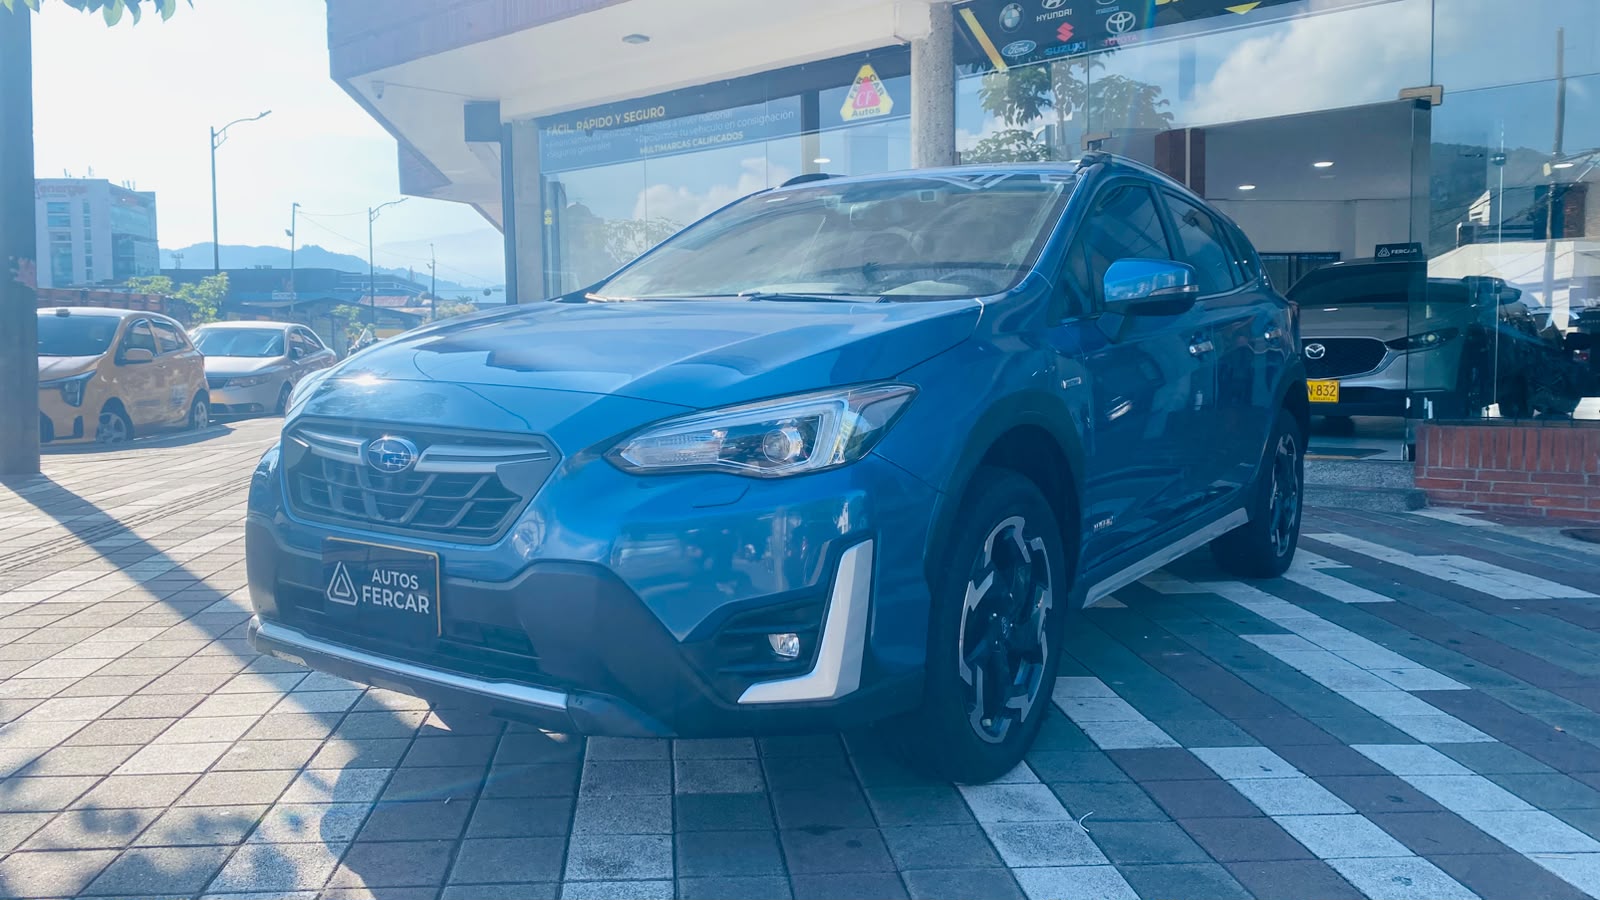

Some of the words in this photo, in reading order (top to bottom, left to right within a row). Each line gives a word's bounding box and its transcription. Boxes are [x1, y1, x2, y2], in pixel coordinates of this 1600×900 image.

[1036, 8, 1073, 22] HYUNDAI
[1103, 34, 1138, 46] TOYOTA
[1044, 41, 1087, 55] SUZUKI
[614, 113, 622, 125] Y
[623, 106, 666, 123] SEGURO
[851, 108, 881, 117] Autos
[724, 120, 736, 130] en
[640, 139, 692, 155] MULTIMARCAS
[692, 131, 744, 147] CALIFICADOS
[372, 569, 419, 590] AUTOS
[362, 585, 430, 615] FERCAR
